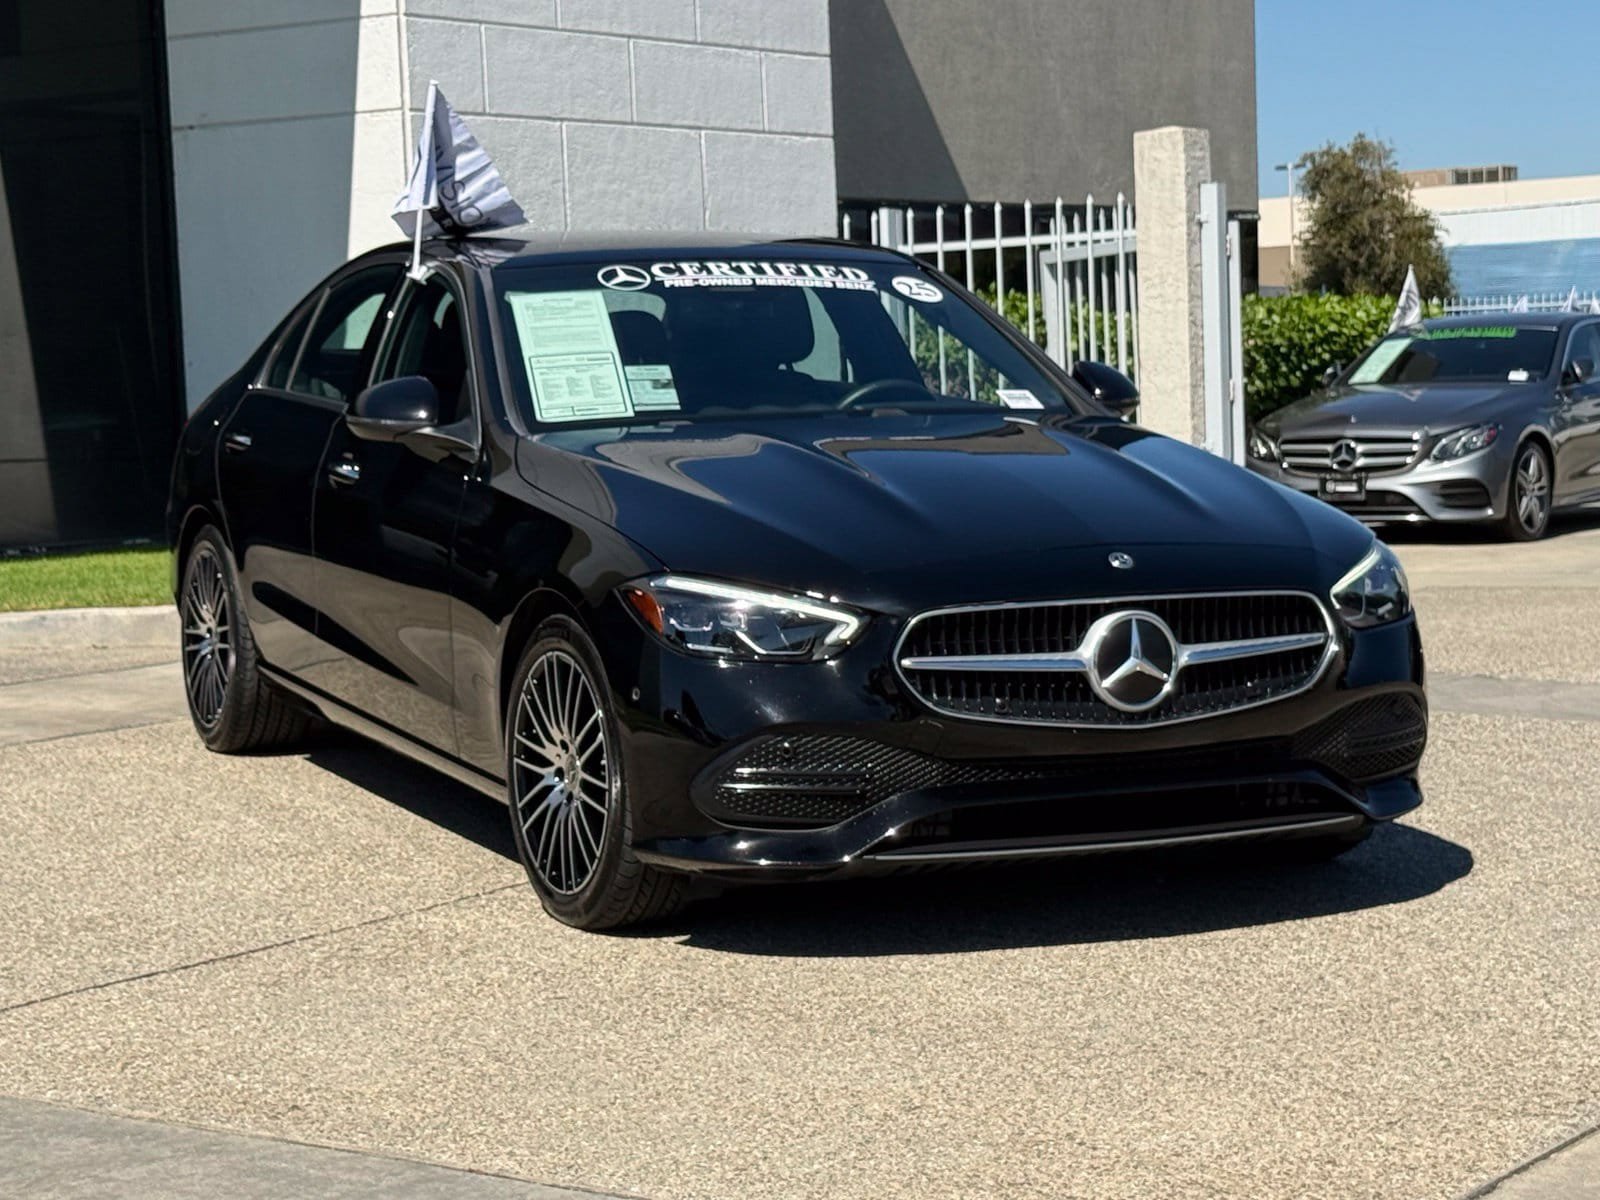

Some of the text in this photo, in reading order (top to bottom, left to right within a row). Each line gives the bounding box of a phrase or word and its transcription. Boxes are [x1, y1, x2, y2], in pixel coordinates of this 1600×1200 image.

[651, 262, 868, 280] CERTIFIED
[663, 278, 875, 291] PRE-OWNED MERCEDES BENZ
[895, 279, 937, 298] 25
